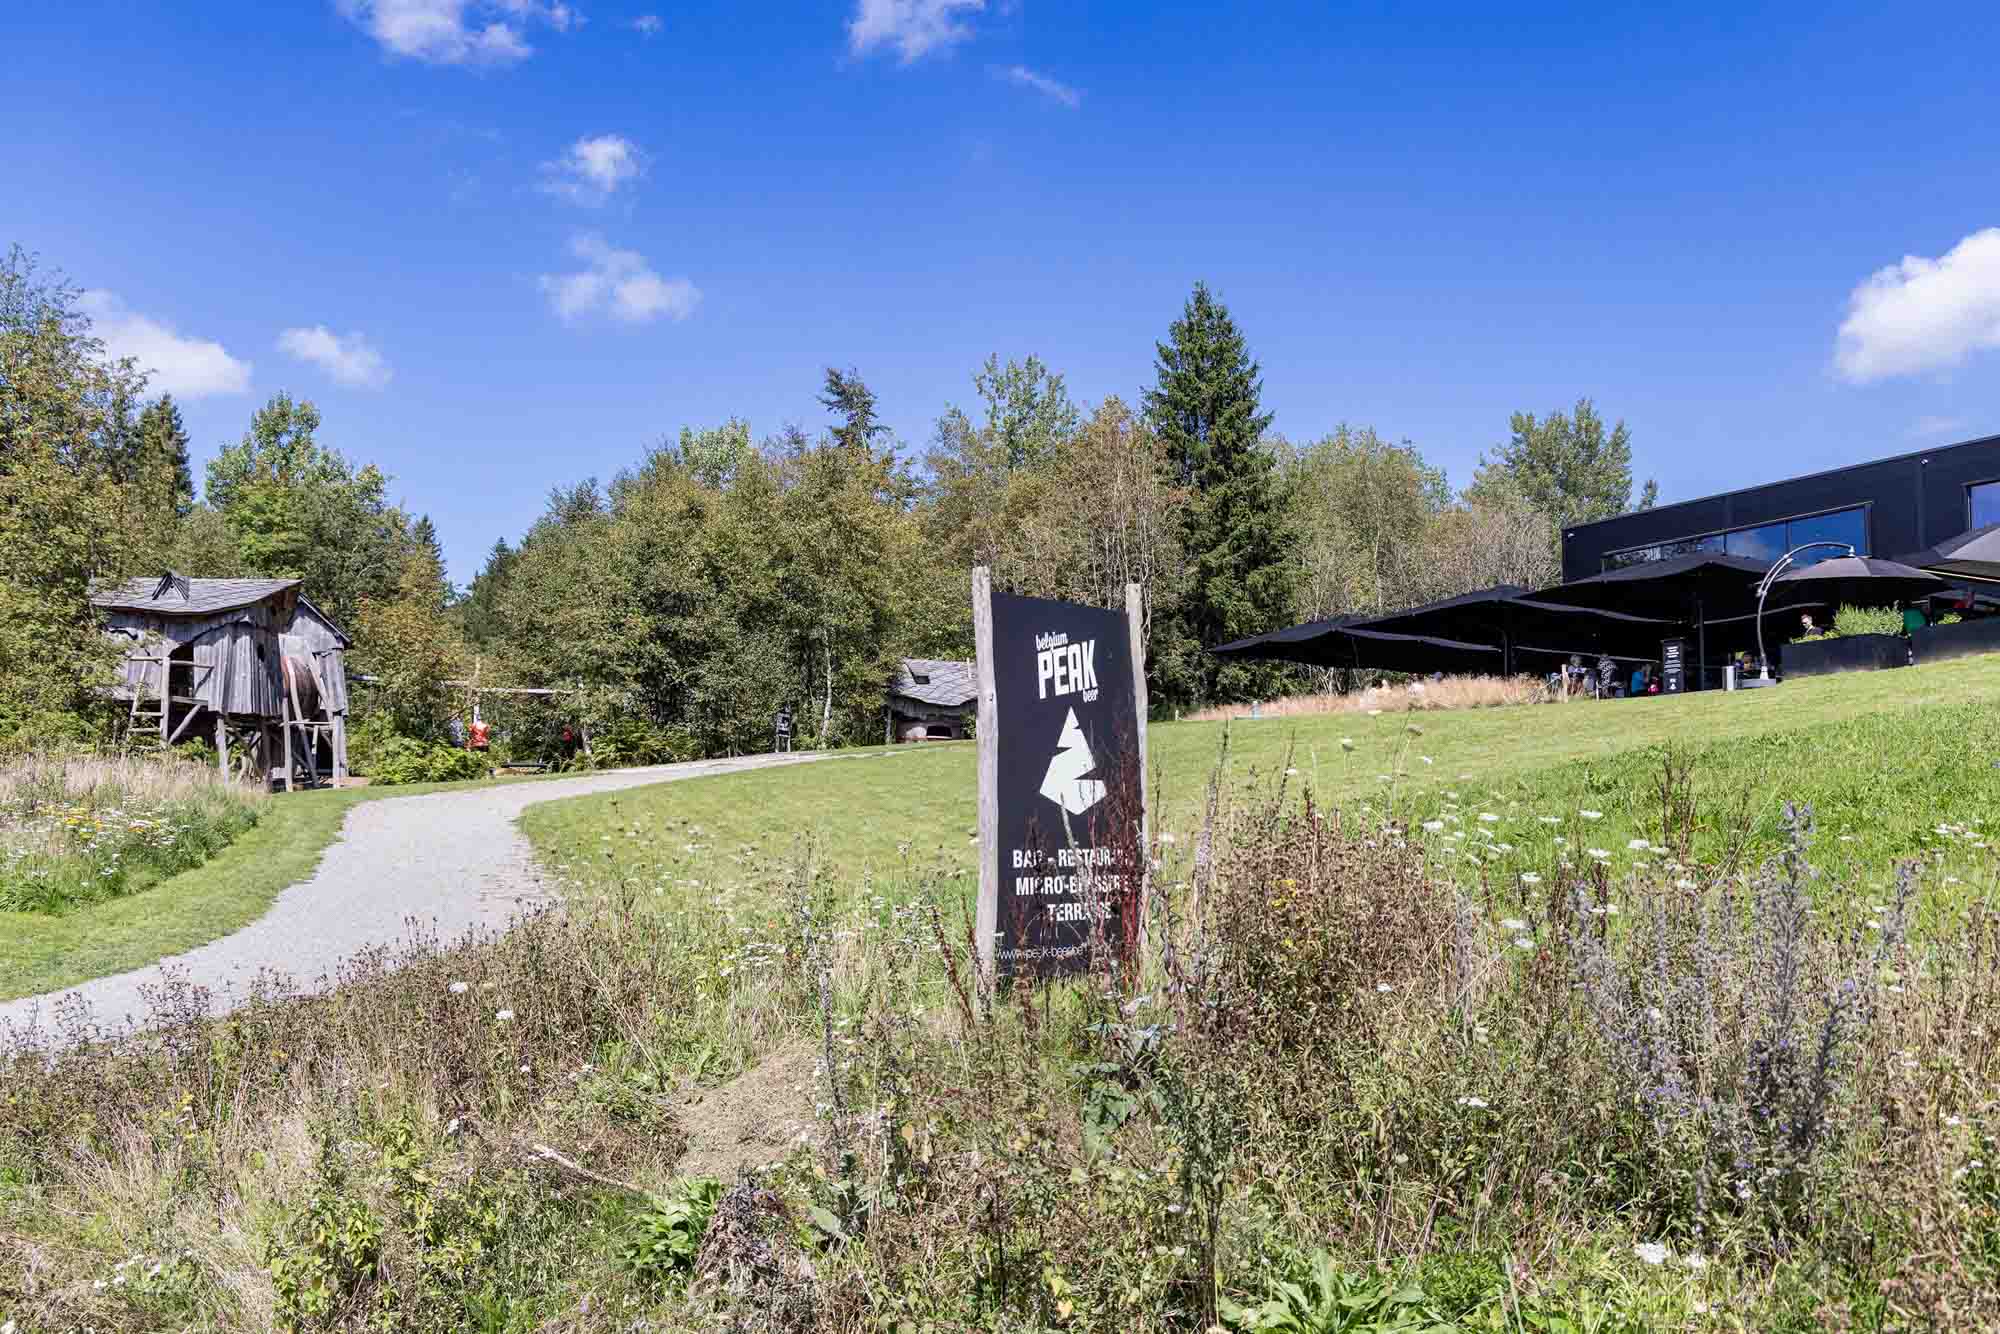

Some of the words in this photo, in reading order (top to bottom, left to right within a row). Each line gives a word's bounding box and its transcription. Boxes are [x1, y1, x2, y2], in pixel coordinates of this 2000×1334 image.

[1035, 631, 1068, 651] belgium
[1038, 639, 1098, 699] PEAK
[1083, 688, 1098, 703] beer
